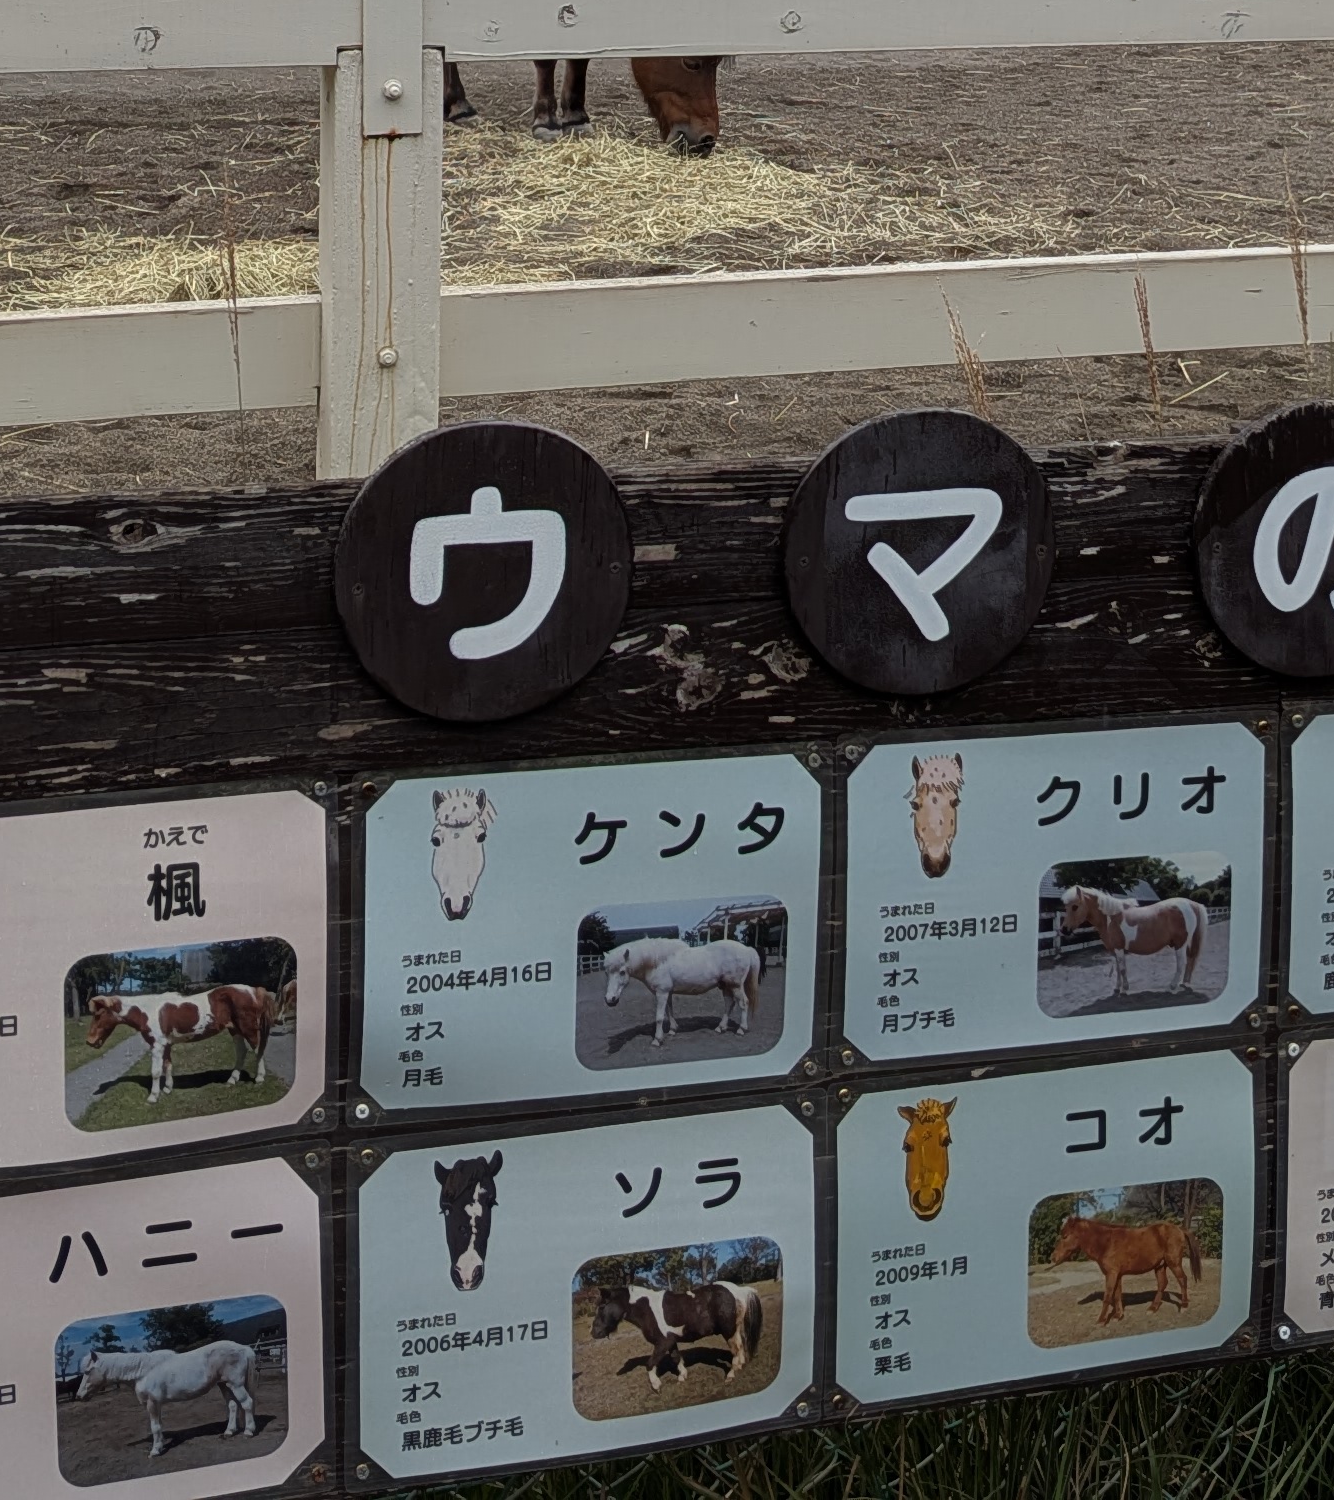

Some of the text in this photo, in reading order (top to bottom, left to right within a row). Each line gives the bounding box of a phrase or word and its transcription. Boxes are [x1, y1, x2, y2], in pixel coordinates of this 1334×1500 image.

[1036, 764, 1227, 827] クリオ
[143, 823, 209, 850] かえで
[574, 801, 785, 865] ケンタ
[146, 861, 207, 922] 楓
[879, 901, 936, 919] うまれた日
[883, 913, 1019, 943] 2007年3月12日
[401, 949, 462, 968] うまれた日
[878, 951, 900, 964] 性別
[406, 961, 553, 994] 2004年4月16日
[882, 967, 920, 988] オス
[399, 1002, 424, 1017] 性別
[876, 994, 900, 1009] 毛色
[405, 1020, 445, 1042] オス
[880, 1007, 956, 1035] 月ブチ毛
[397, 1048, 424, 1064] 毛色
[402, 1066, 444, 1088] 月毛
[1065, 1095, 1185, 1154] コオ
[614, 1157, 742, 1219] ソラ
[48, 1219, 284, 1284] ハニー
[870, 1243, 927, 1263] うまれた日
[874, 1255, 969, 1288] 2009年1月
[870, 1293, 892, 1307] 性別
[395, 1312, 457, 1332] うまれた日
[873, 1308, 912, 1331] オス
[401, 1319, 549, 1357] 2006年4月17日
[868, 1337, 893, 1352] 毛色
[395, 1364, 420, 1379] 性別
[873, 1351, 912, 1377] 栗毛
[401, 1381, 443, 1404] オス
[395, 1410, 422, 1425] 毛色
[401, 1414, 524, 1453] 黒鹿毛ブチ毛
